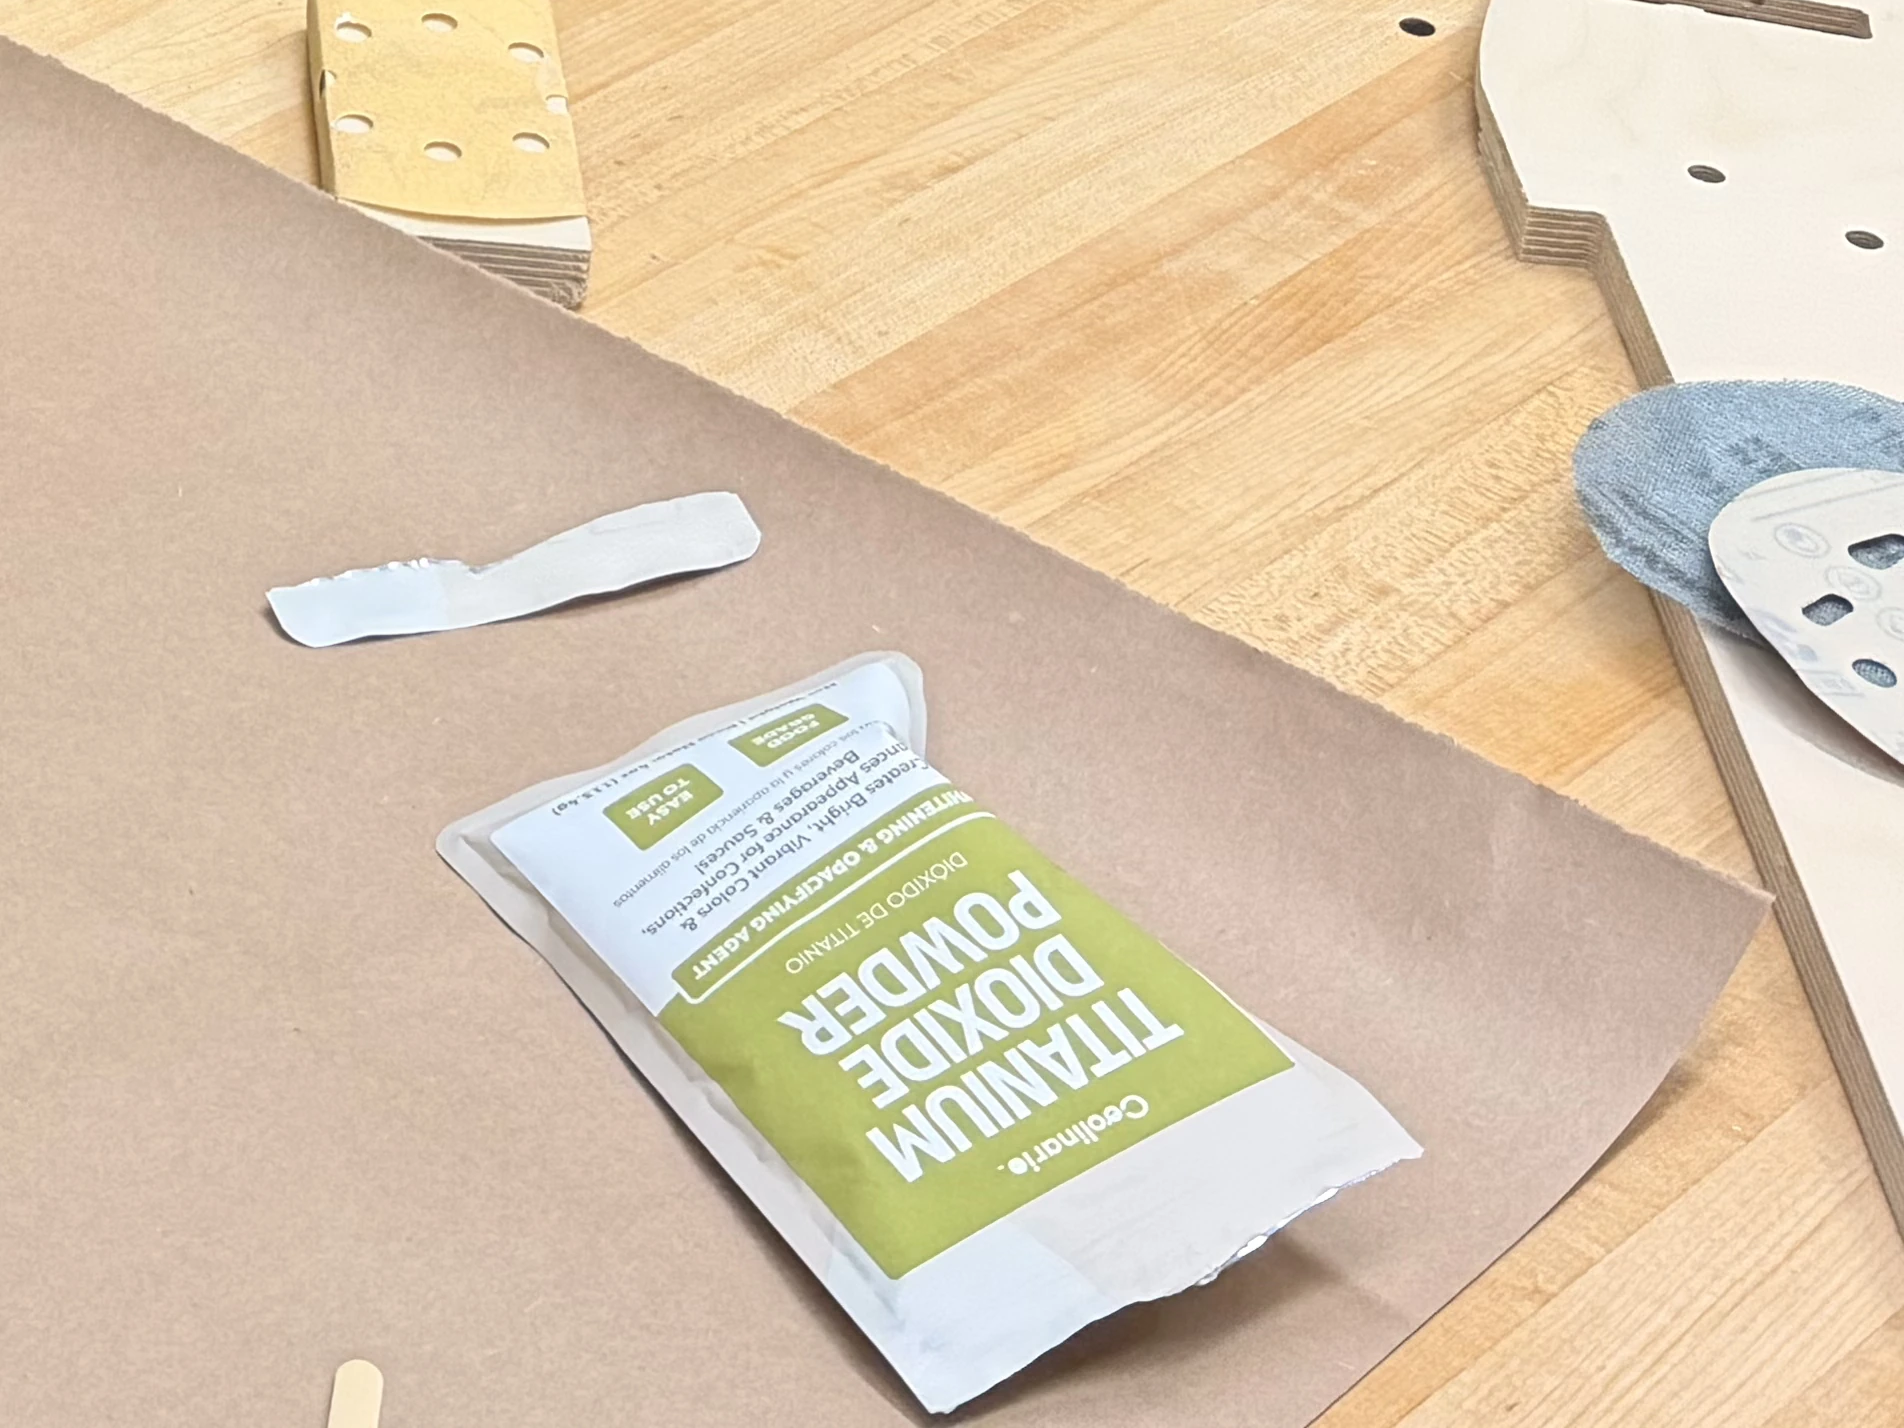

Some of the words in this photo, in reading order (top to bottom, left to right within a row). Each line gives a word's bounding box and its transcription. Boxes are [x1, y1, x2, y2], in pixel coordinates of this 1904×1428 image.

[750, 712, 816, 746] GRADE
[766, 719, 821, 749] FOOD
[859, 741, 909, 774] ances
[662, 777, 691, 797] TO
[769, 776, 785, 790] la
[772, 749, 862, 815] Beverages
[623, 793, 659, 821] USE
[645, 788, 695, 827] EASY
[706, 786, 772, 838] apariencia
[754, 810, 776, 827] &
[762, 771, 862, 846] Appearance
[806, 793, 868, 833] Bright,
[670, 844, 692, 866] los
[688, 830, 709, 850] de
[694, 821, 756, 876] Sauces!
[738, 835, 766, 866] for
[746, 831, 813, 881] Vibrant
[857, 836, 879, 855] &
[613, 858, 671, 910] alimentos
[641, 860, 742, 936] Confections,
[695, 877, 750, 919] Colors
[749, 850, 860, 932] OPACIFYING
[886, 851, 969, 910] DIÓXIDO
[680, 914, 698, 933] &
[856, 902, 889, 929] DE
[690, 926, 750, 981] AGENT
[775, 869, 1063, 1056] POWDER
[785, 920, 859, 975] TITANIO
[838, 933, 1105, 1110] DIOXIDE
[865, 987, 1185, 1184] TITANIUM
